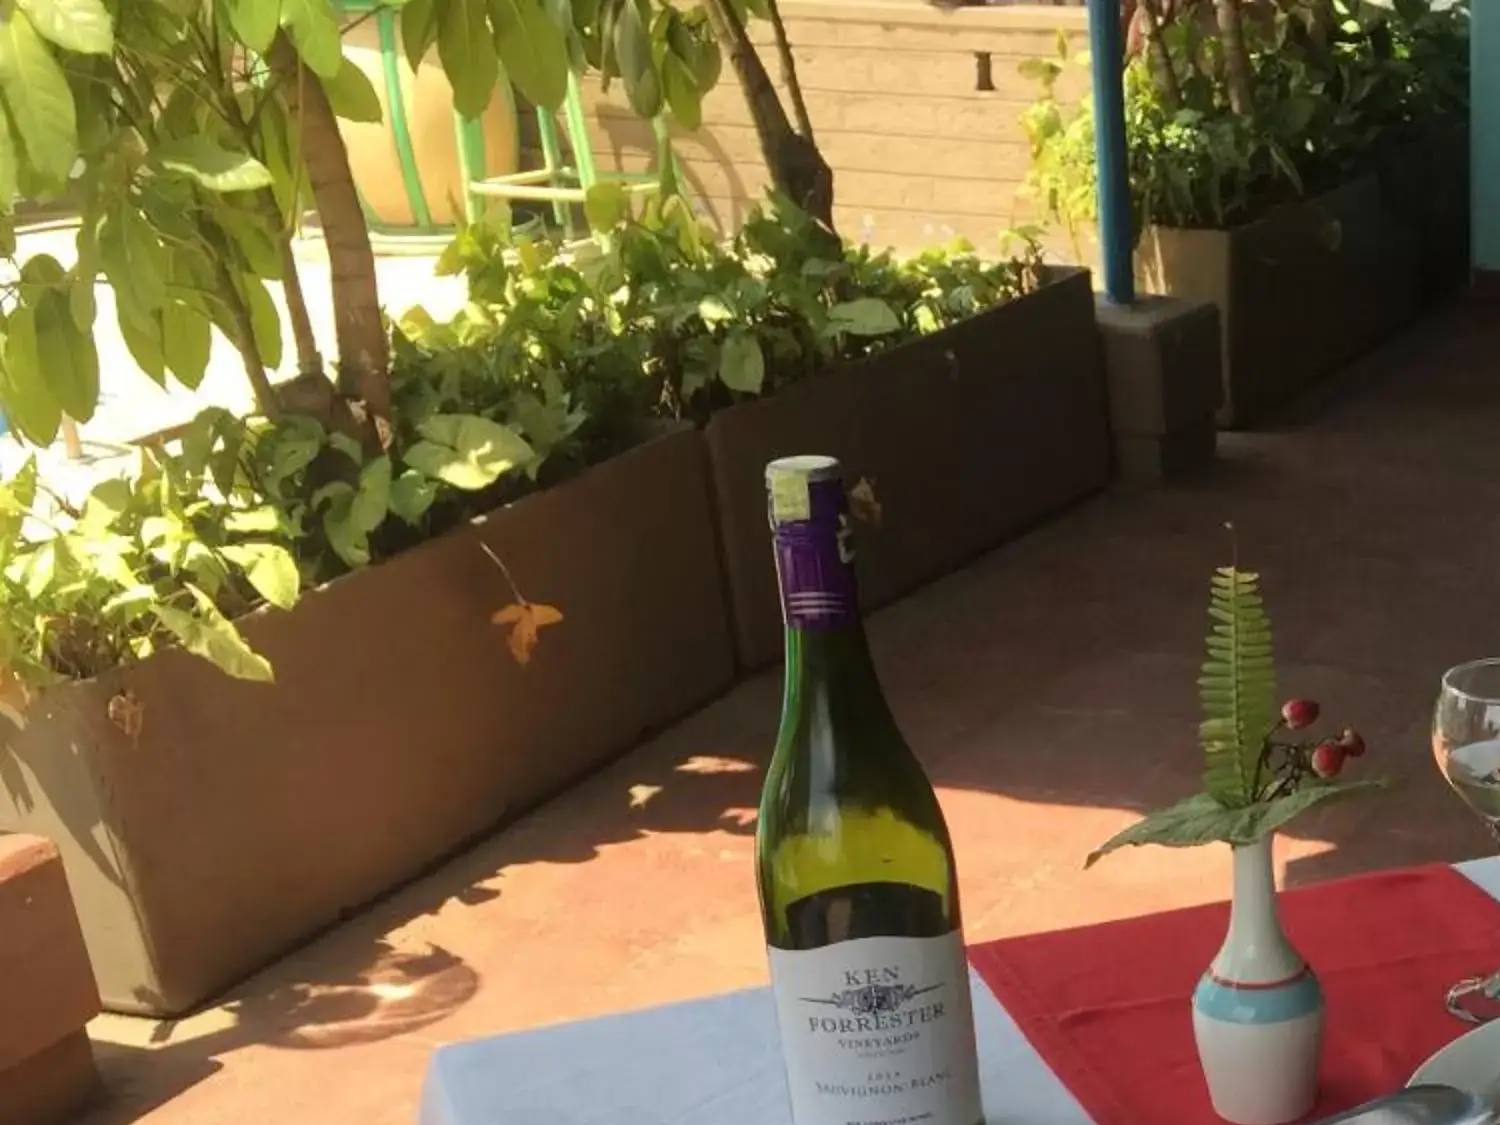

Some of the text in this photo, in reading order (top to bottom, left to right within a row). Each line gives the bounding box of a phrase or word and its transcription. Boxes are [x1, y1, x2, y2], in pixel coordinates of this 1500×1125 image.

[843, 965, 900, 986] KEN
[808, 1001, 946, 1033] FORRESTER
[837, 1031, 920, 1049] VINEYARDS
